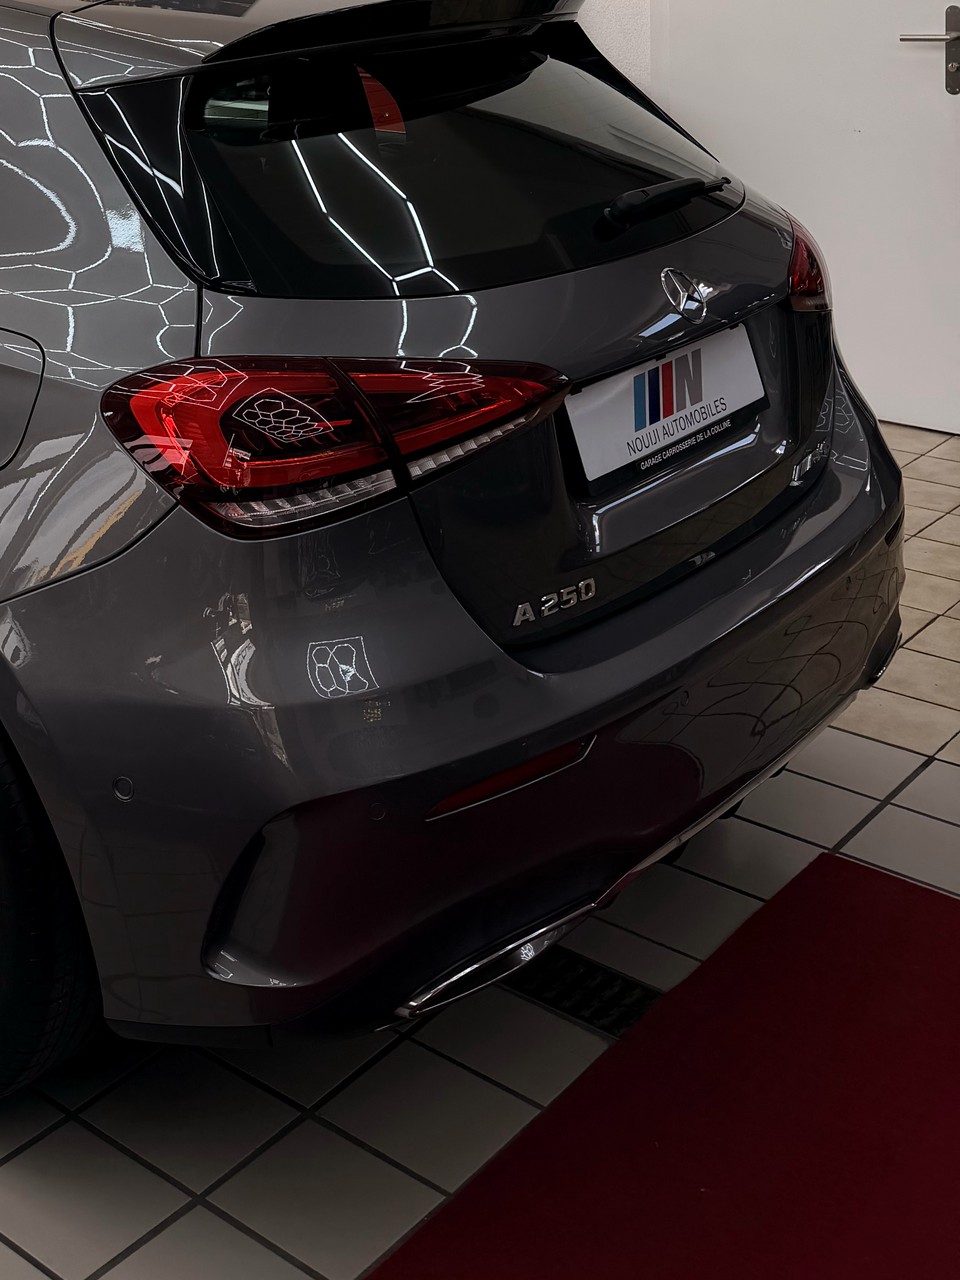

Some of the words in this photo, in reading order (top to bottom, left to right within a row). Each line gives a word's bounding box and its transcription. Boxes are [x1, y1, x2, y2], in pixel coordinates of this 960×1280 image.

[626, 428, 661, 457] NOUIJI
[662, 396, 728, 440] AUTOMOBILES
[640, 453, 663, 471] GARAGE
[662, 436, 697, 460] CARROSSERIE
[711, 419, 732, 436] COLLINE
[512, 602, 536, 627] A
[540, 577, 596, 618] 250
